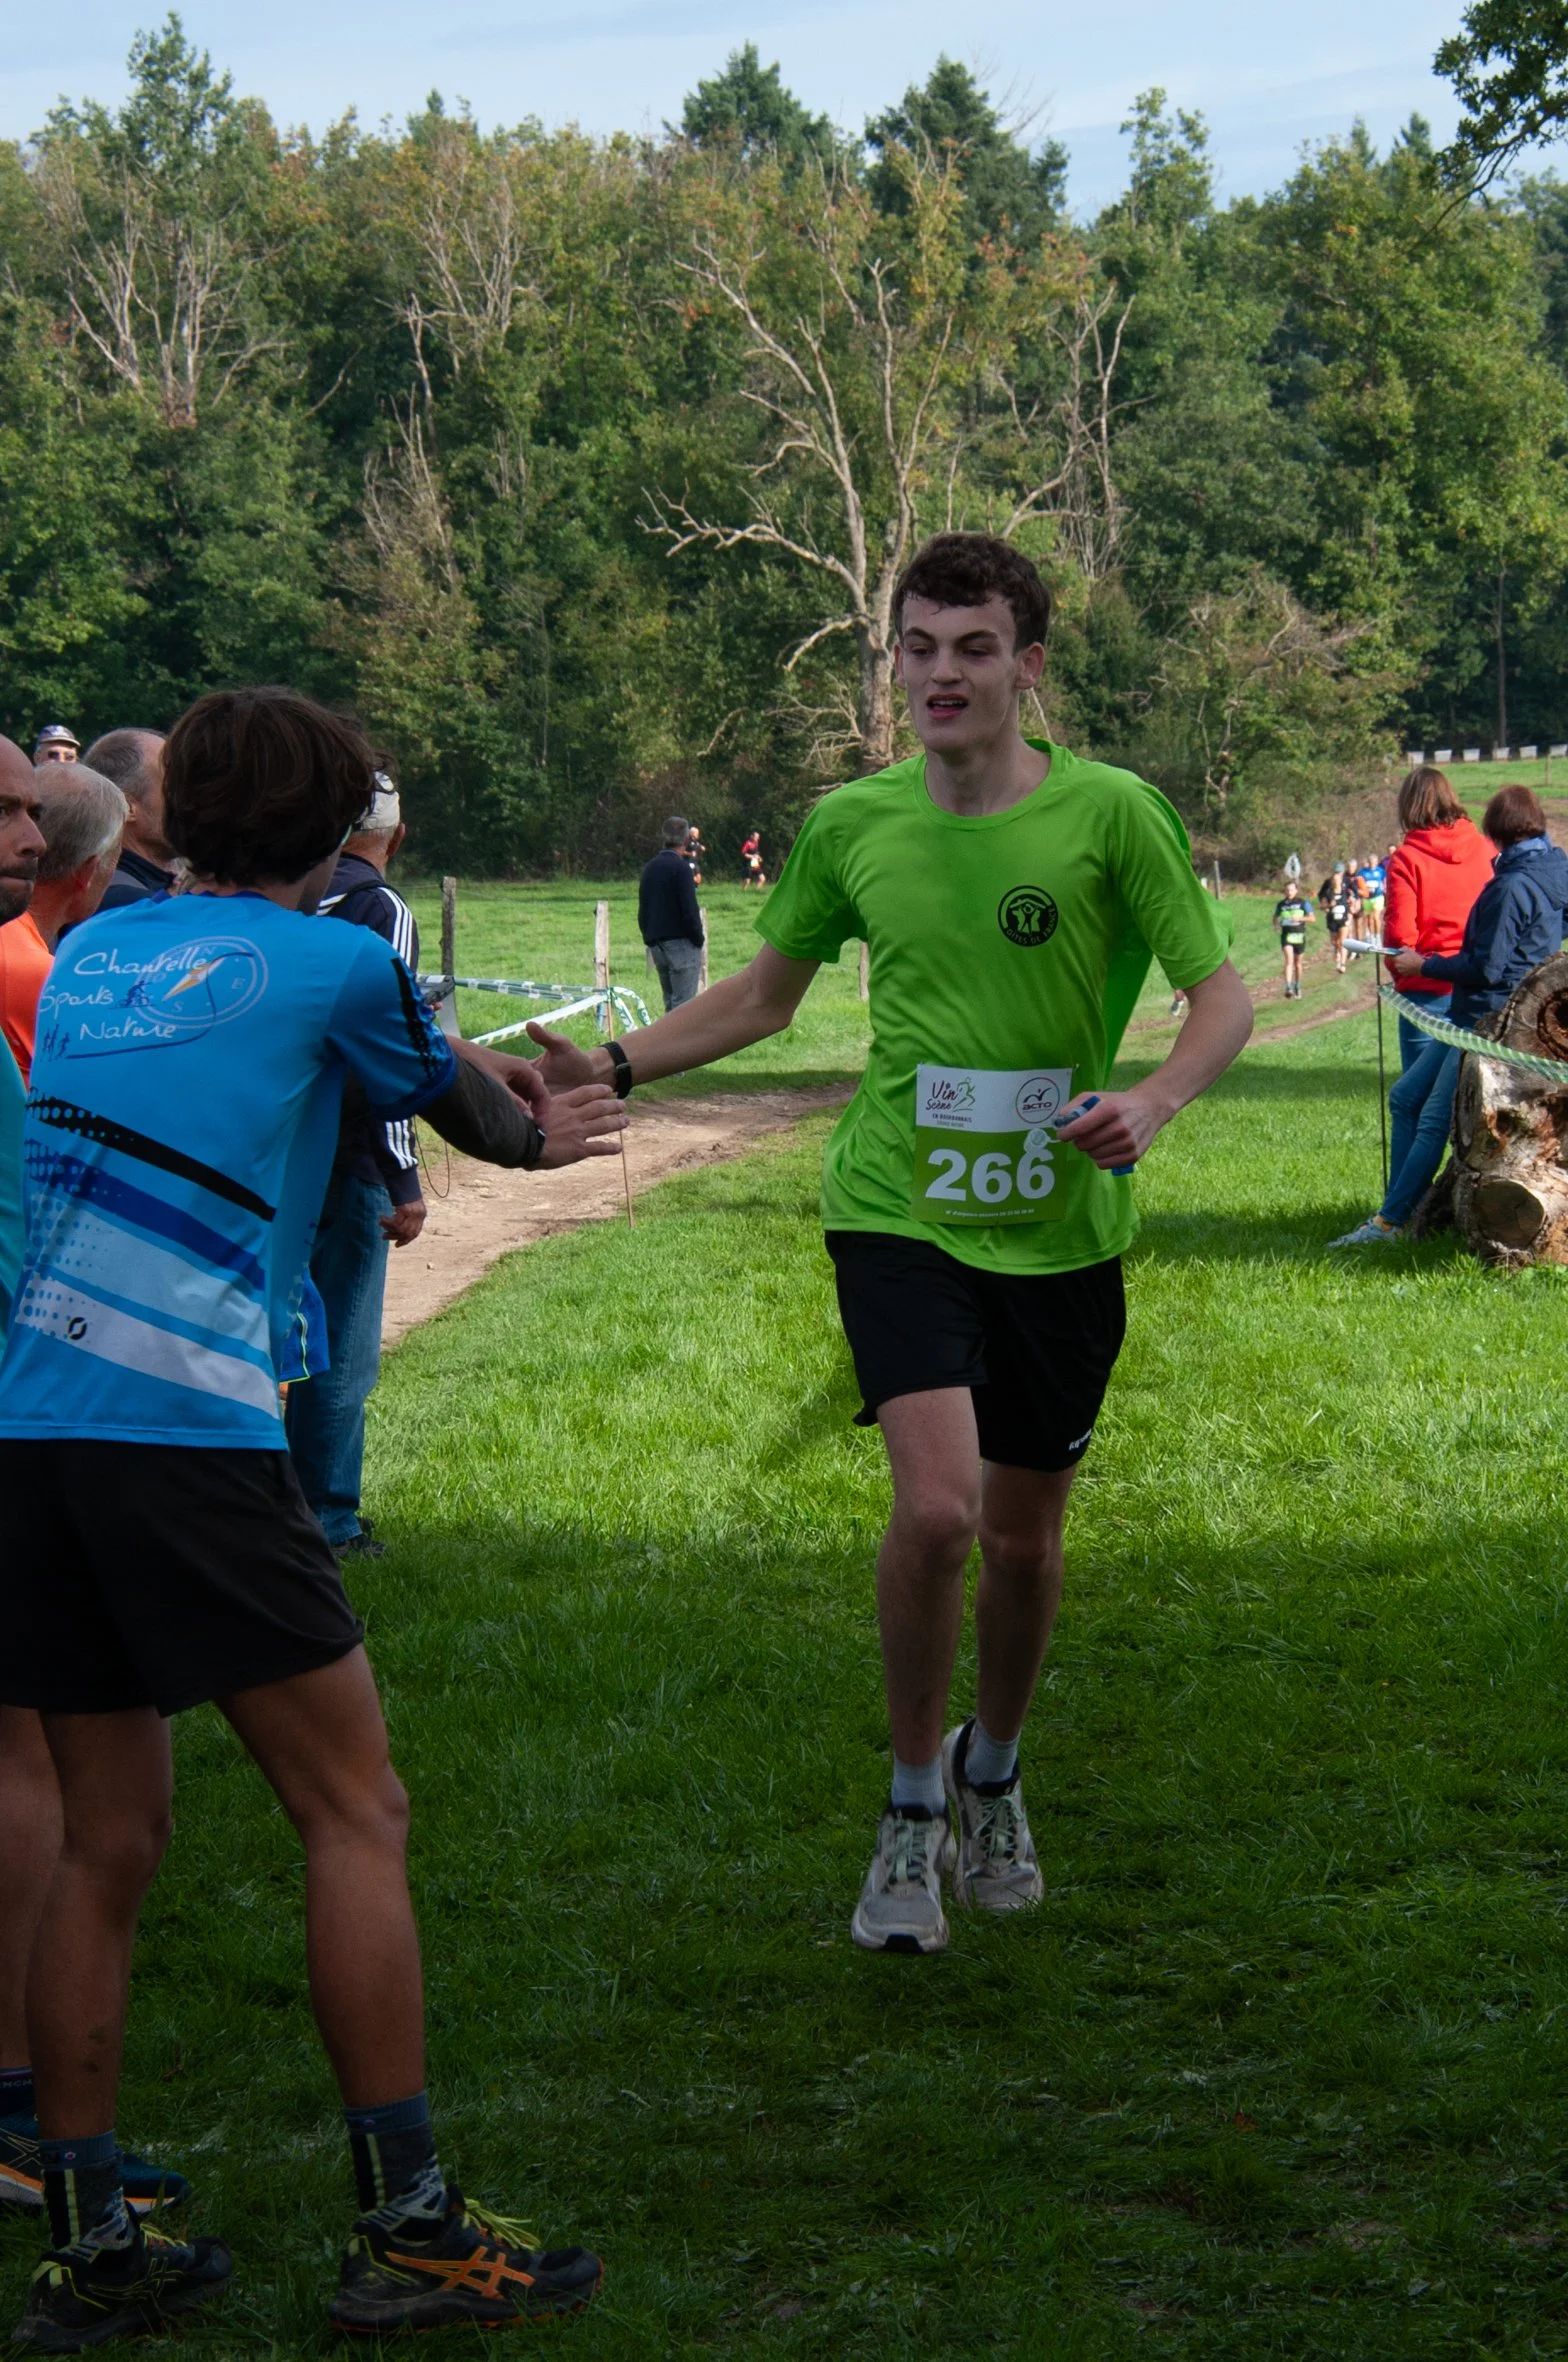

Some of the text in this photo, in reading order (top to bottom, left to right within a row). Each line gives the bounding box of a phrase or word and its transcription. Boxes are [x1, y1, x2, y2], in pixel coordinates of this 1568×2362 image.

[75, 947, 207, 975] Chantelle
[80, 1016, 177, 1040] Nature
[932, 1080, 959, 1101] Vin
[926, 1149, 1055, 1203] 266
